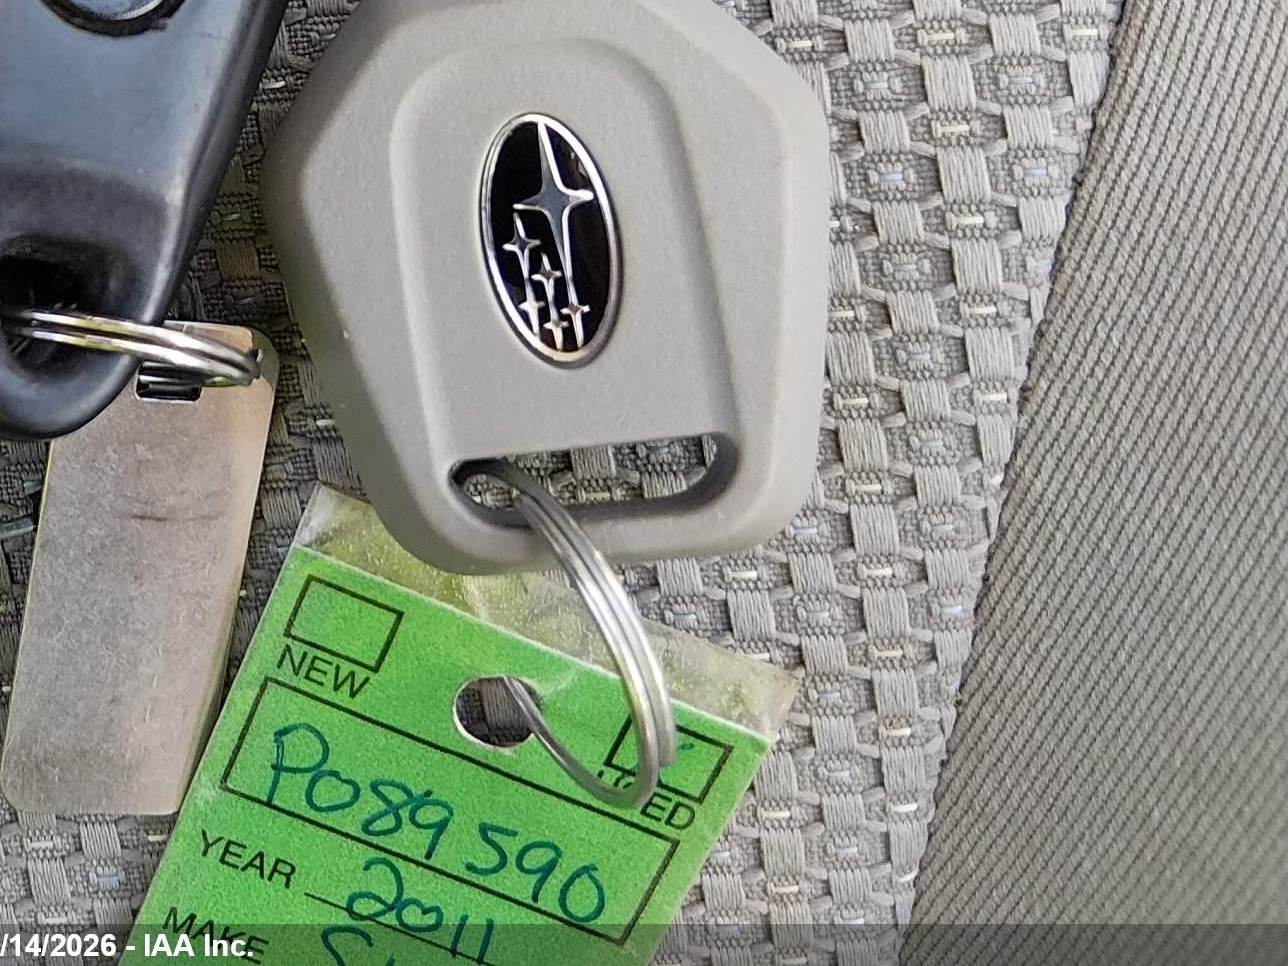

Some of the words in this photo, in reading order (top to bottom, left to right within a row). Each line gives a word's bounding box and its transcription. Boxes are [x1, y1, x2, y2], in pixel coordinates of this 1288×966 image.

[276, 643, 371, 699] NEW
[200, 828, 297, 889] YEAR
[162, 906, 270, 965] MAKE
[346, 856, 495, 965] 2011
